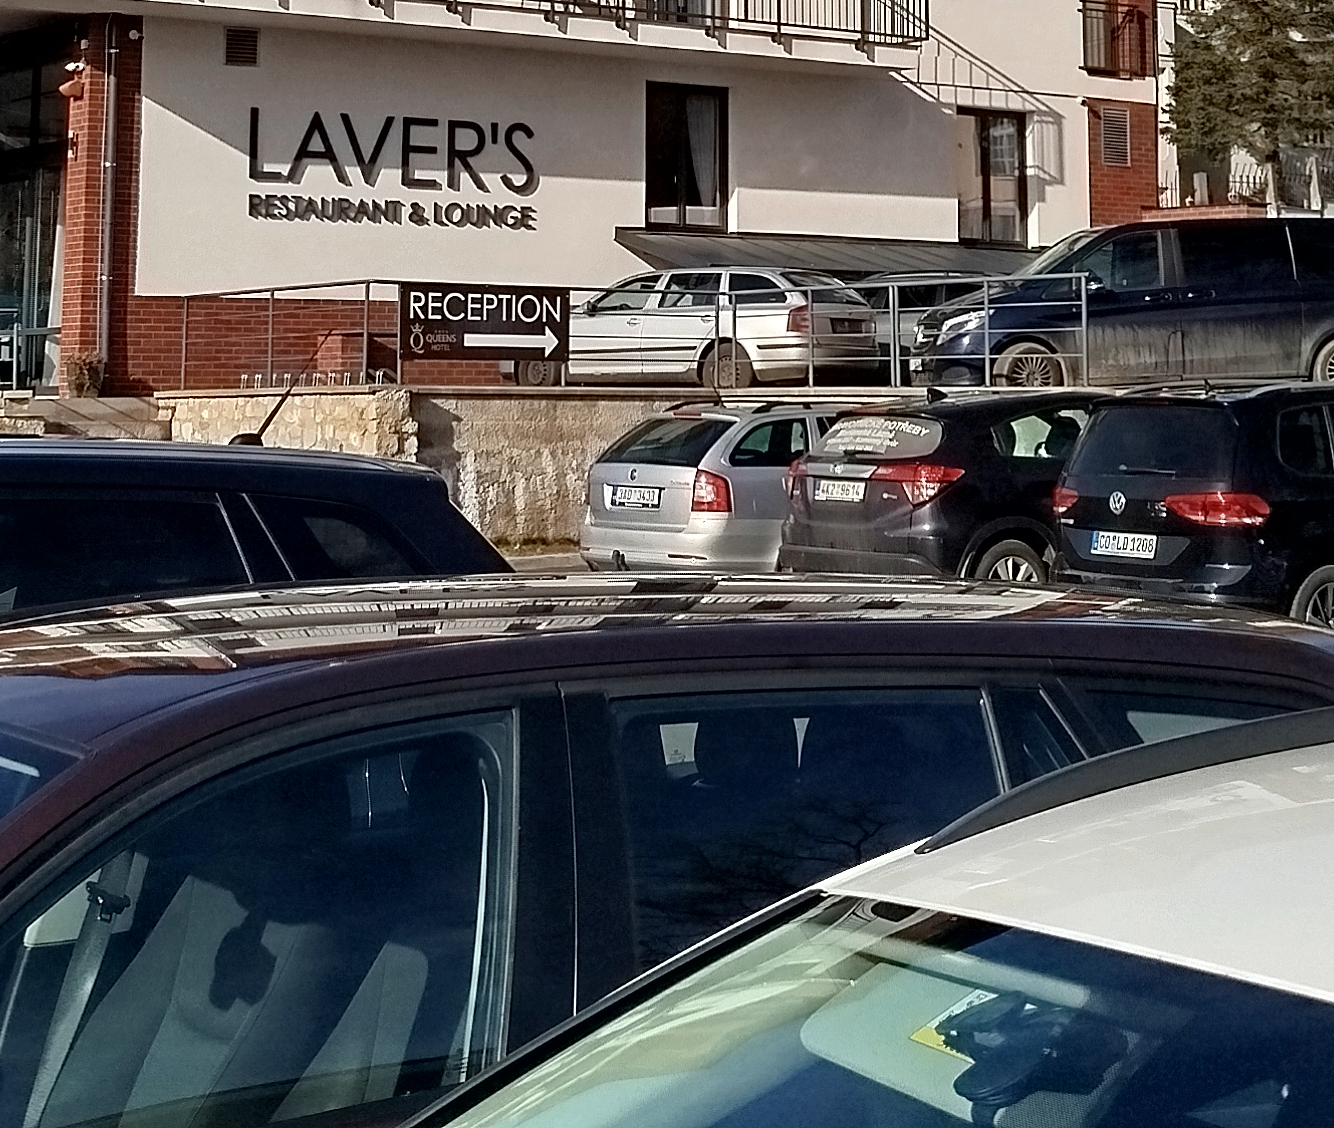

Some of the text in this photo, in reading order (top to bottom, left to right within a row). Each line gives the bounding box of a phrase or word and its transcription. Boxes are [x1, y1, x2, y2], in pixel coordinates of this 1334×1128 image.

[248, 106, 542, 197] LAVER'S
[248, 193, 538, 231] RESTAURANT & LOUNGE
[409, 291, 561, 323] RECEPTION
[425, 333, 457, 344] QUEENS
[430, 343, 451, 351] HOTEL
[882, 419, 930, 437] POTŘEBY
